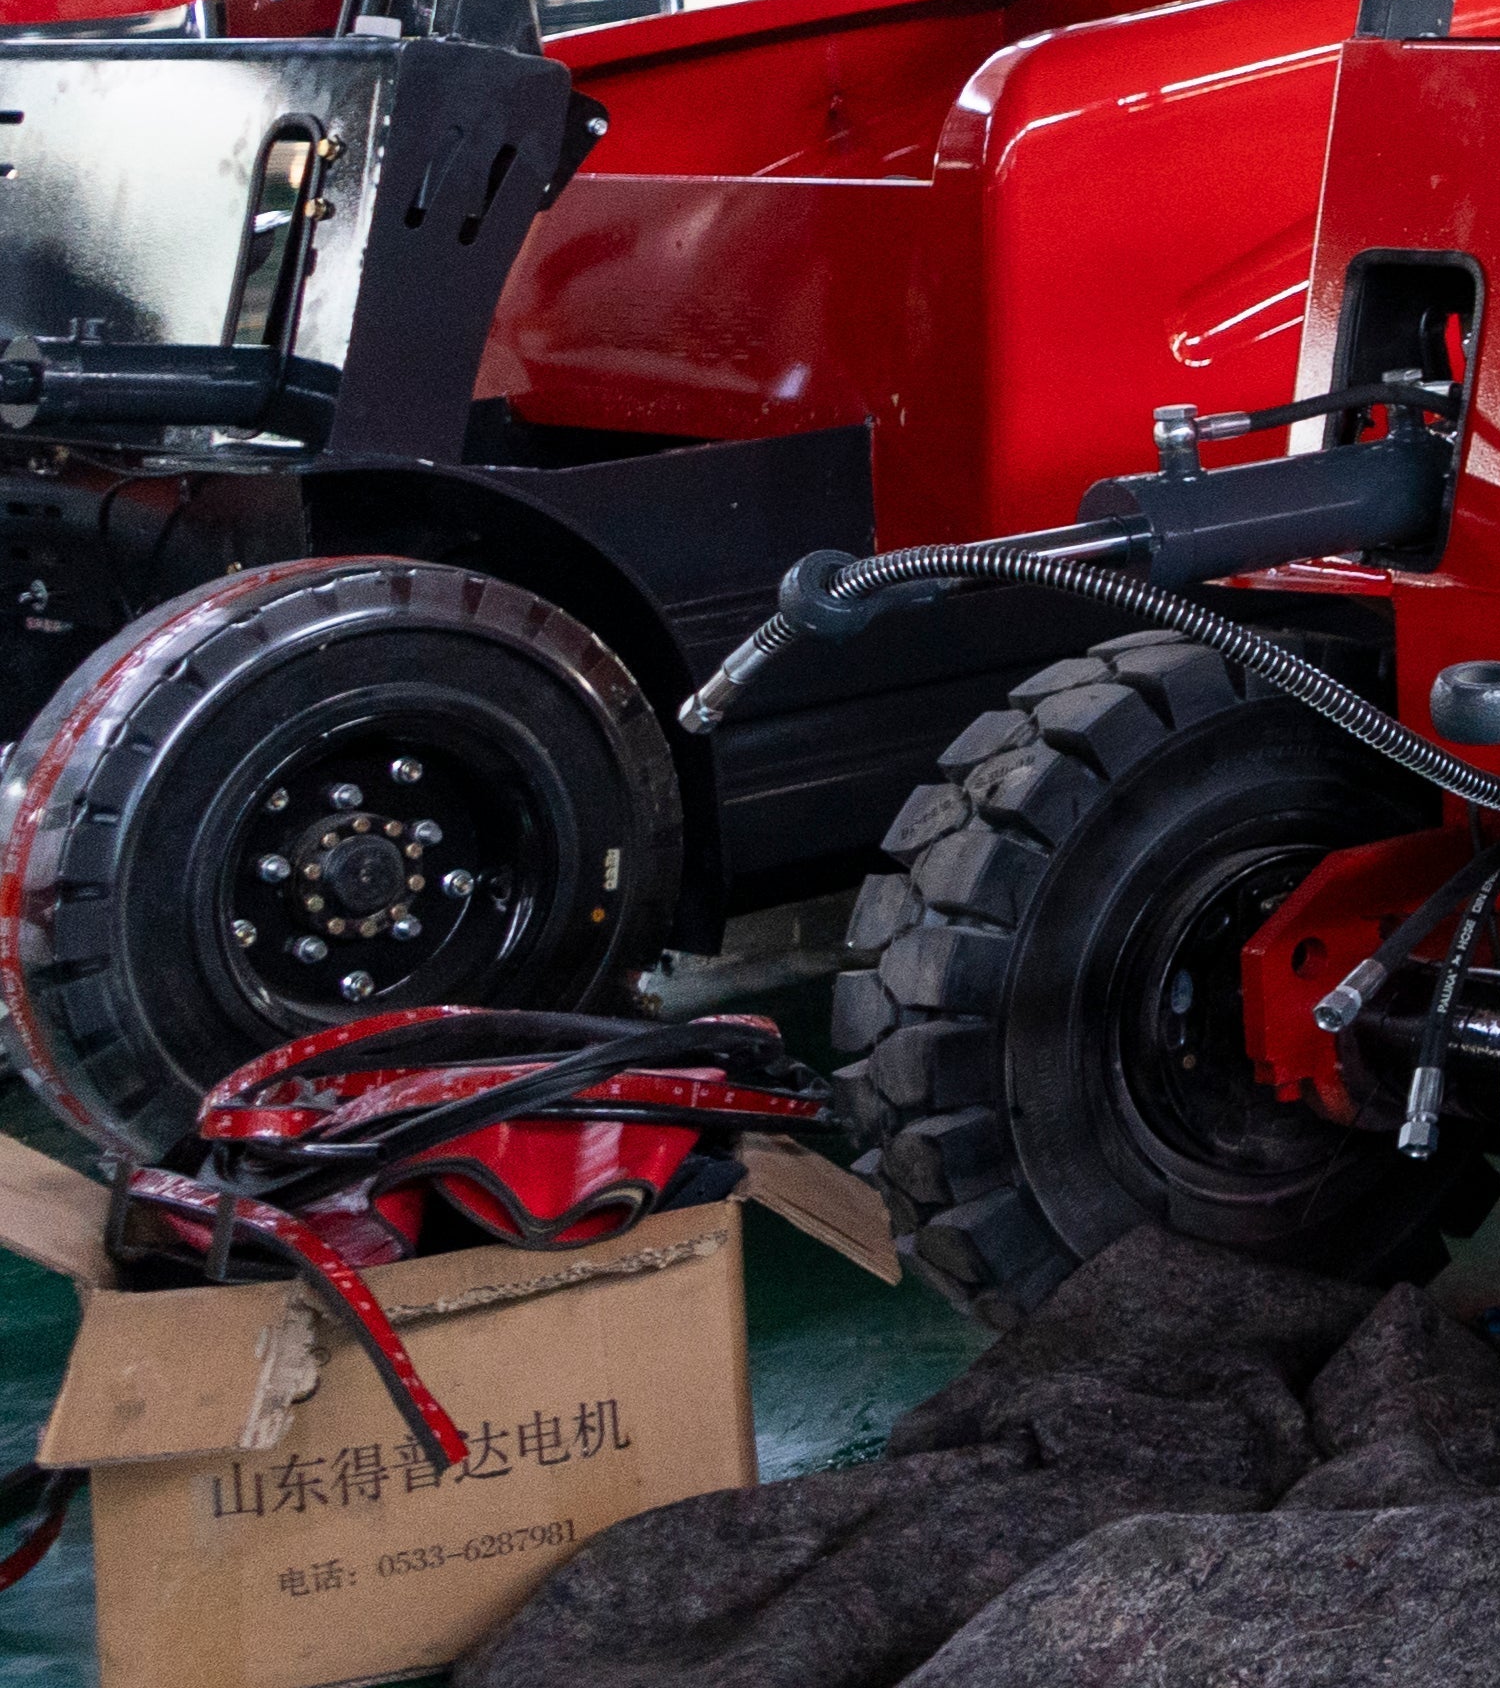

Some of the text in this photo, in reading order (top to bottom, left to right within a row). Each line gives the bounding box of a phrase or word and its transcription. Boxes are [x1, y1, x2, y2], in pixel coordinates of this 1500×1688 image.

[1456, 918, 1477, 951] HOSE
[211, 1398, 631, 1519] 山东得普达电机
[376, 1518, 578, 1579] 0533-6287981
